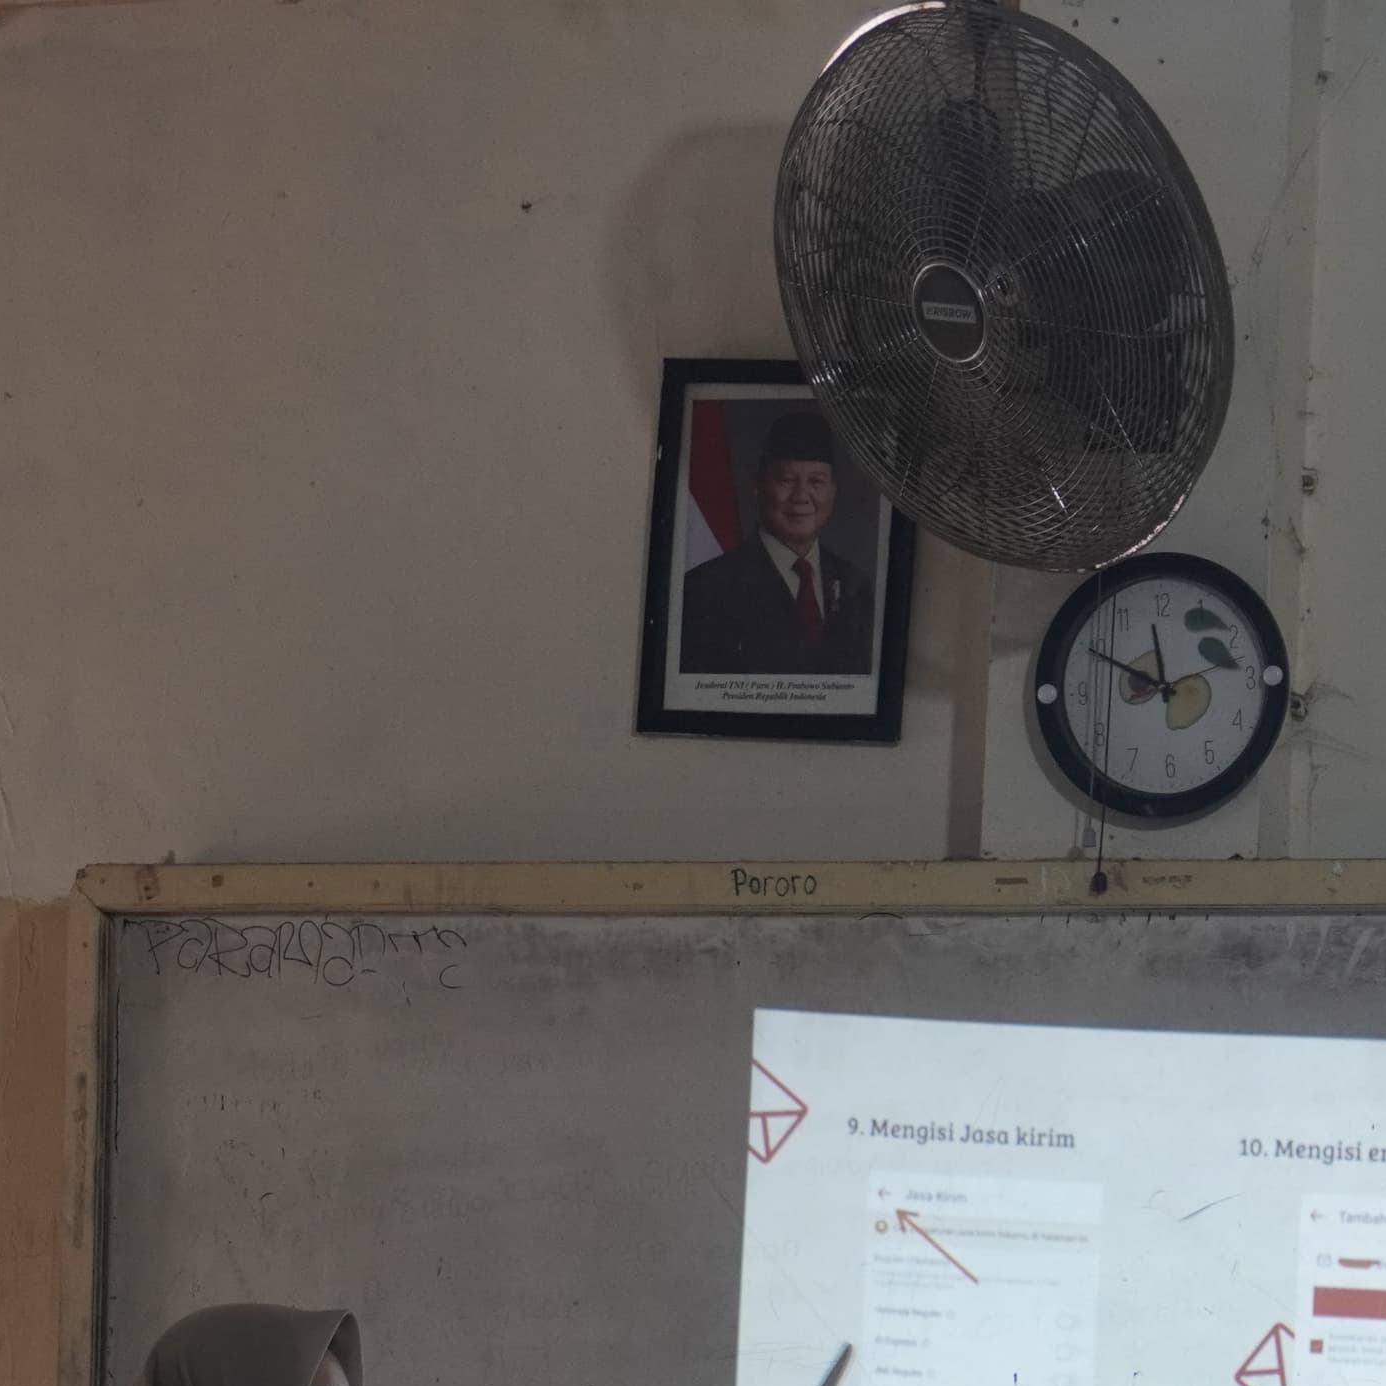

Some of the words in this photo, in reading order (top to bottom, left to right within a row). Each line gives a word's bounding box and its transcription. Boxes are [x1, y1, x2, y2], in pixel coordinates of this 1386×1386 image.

[1153, 592, 1171, 618] 12
[1117, 607, 1131, 633] 11
[1228, 624, 1239, 649] 2
[1244, 664, 1256, 690] 3
[1076, 681, 1088, 706] 9
[1231, 707, 1244, 732] 4
[1125, 747, 1140, 772] 7
[1164, 752, 1176, 778] 6
[1203, 739, 1215, 765] 5
[730, 868, 818, 897] Pororo
[846, 1116, 864, 1137] 9.
[869, 1117, 955, 1146] Mengisi
[959, 1124, 1010, 1146] Jasa
[1015, 1126, 1076, 1150] kirim
[1239, 1138, 1268, 1158] 10.
[1274, 1138, 1363, 1166] Mengisi
